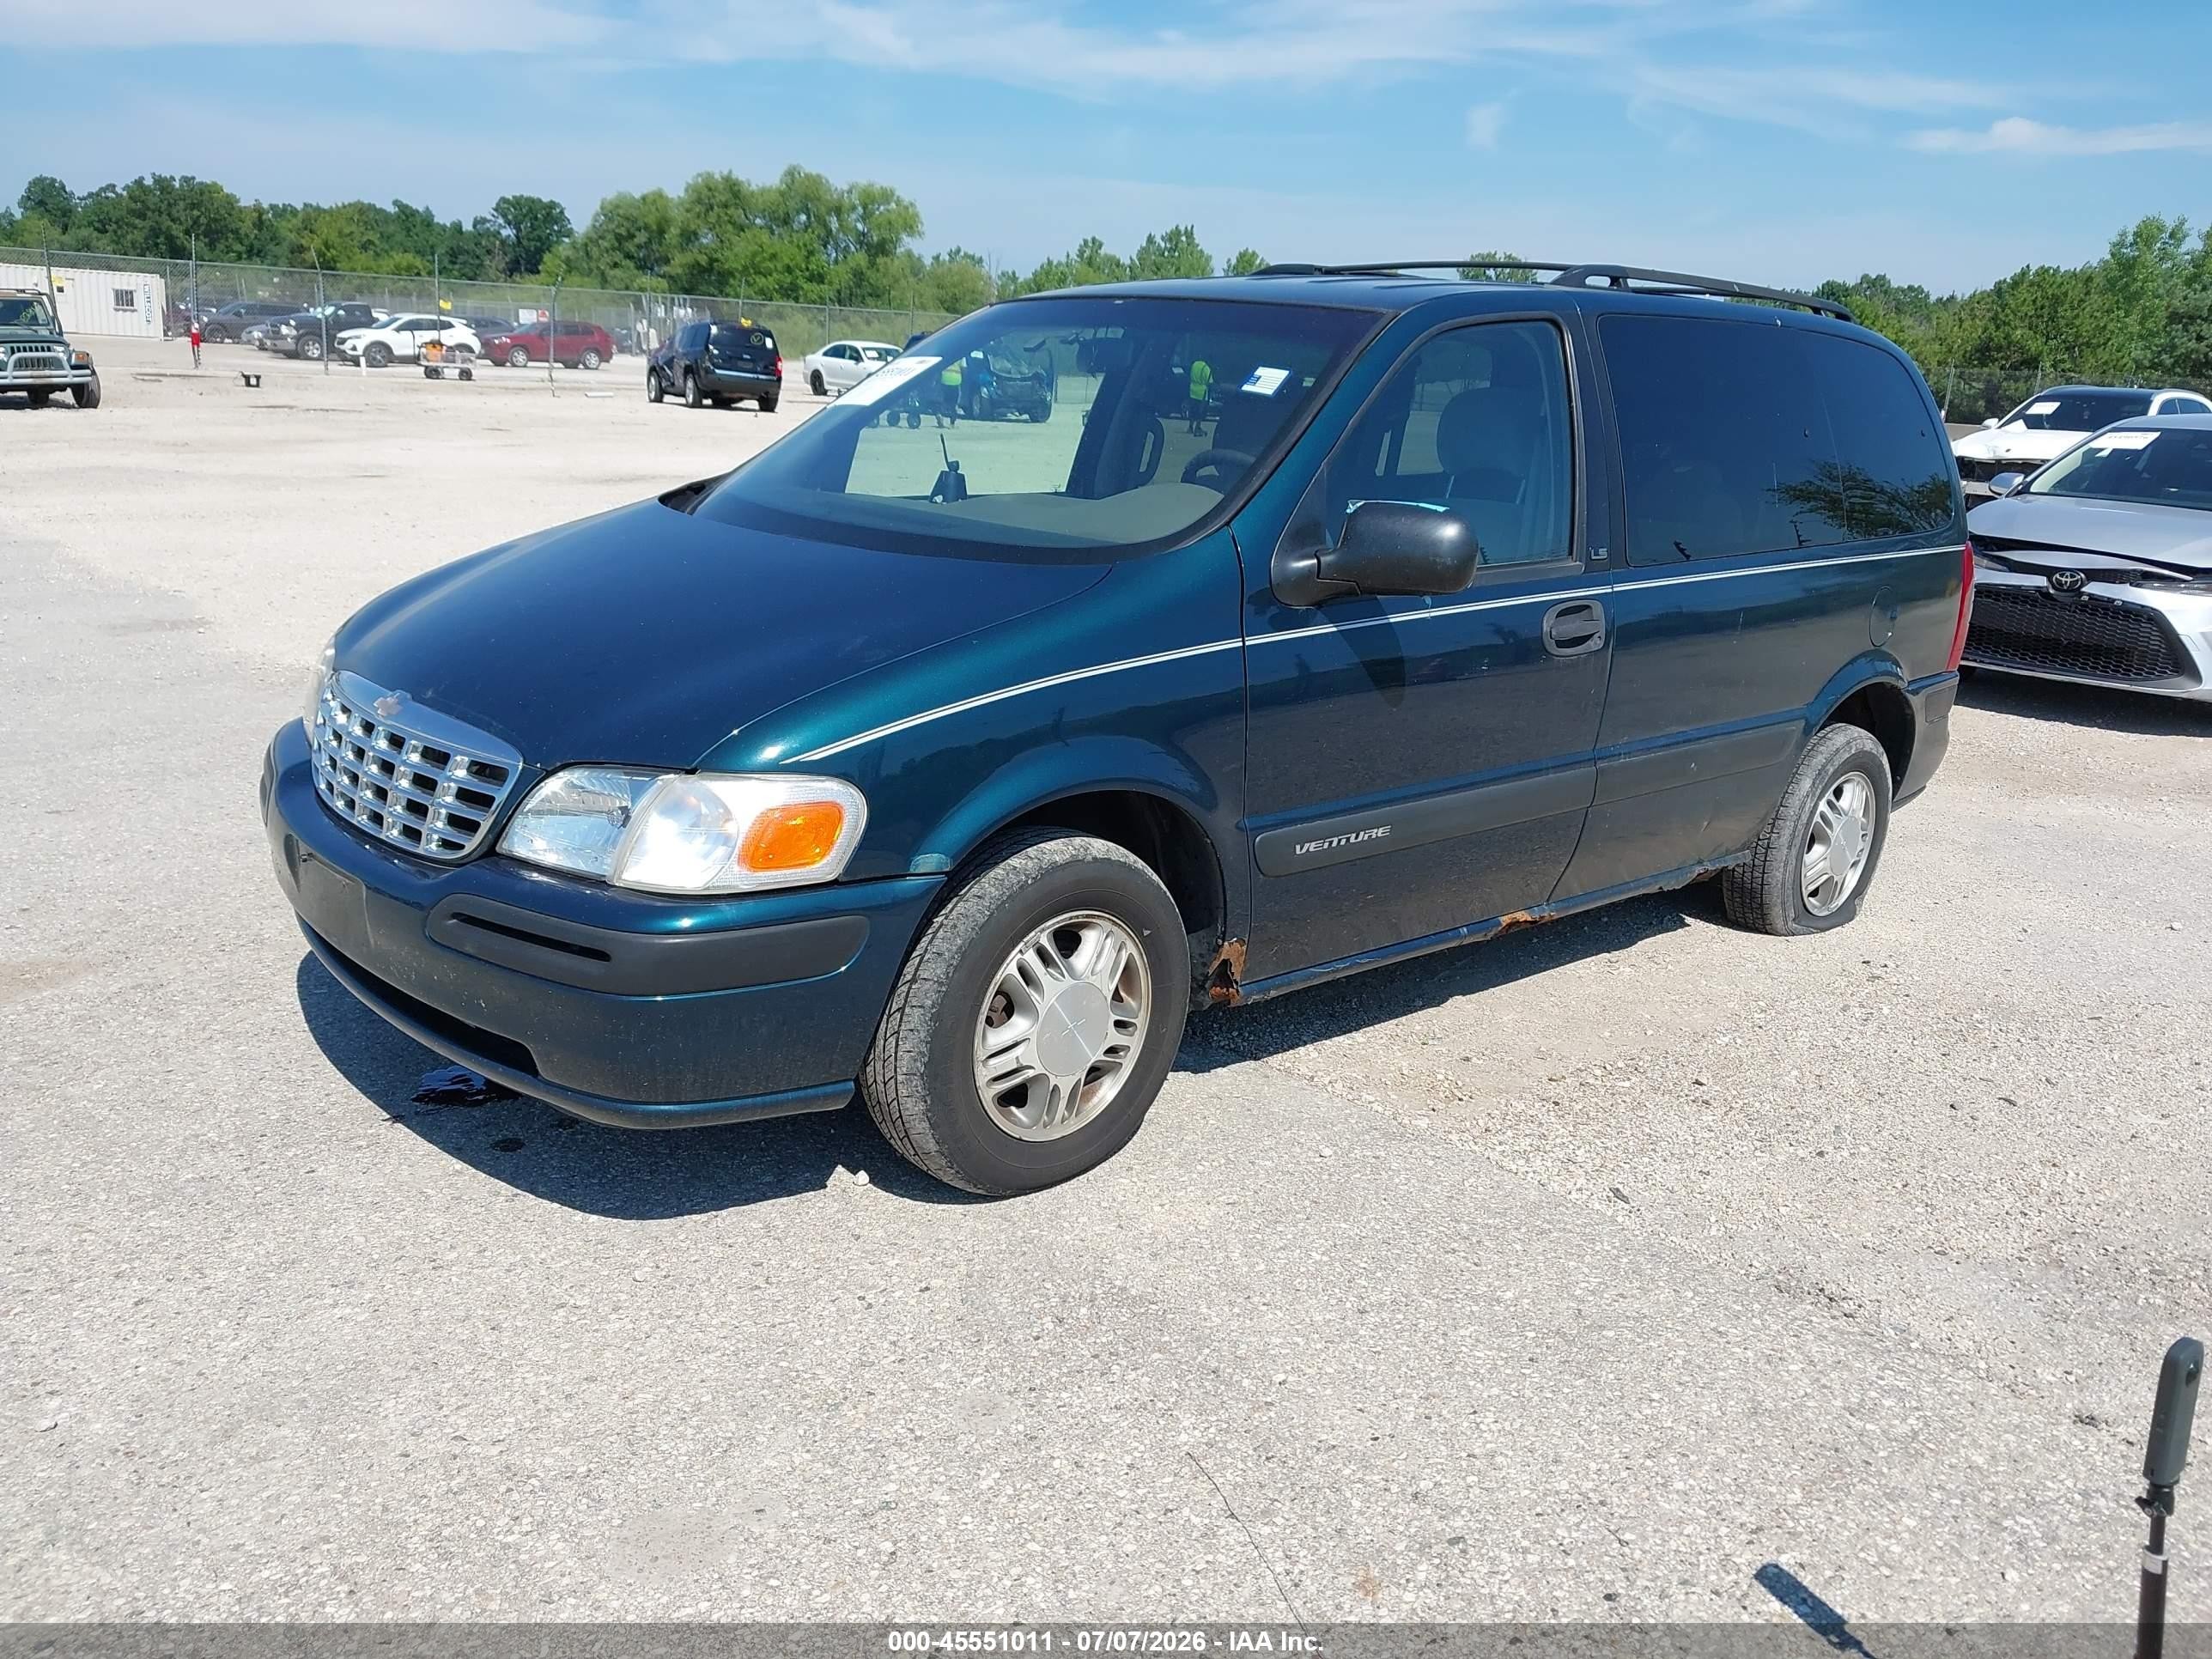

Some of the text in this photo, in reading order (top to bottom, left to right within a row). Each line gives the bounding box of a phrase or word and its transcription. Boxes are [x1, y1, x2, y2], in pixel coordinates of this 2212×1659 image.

[143, 283, 152, 324] WILLSCOT
[1590, 548, 1607, 559] LS
[1295, 825, 1391, 854] VENTURE
